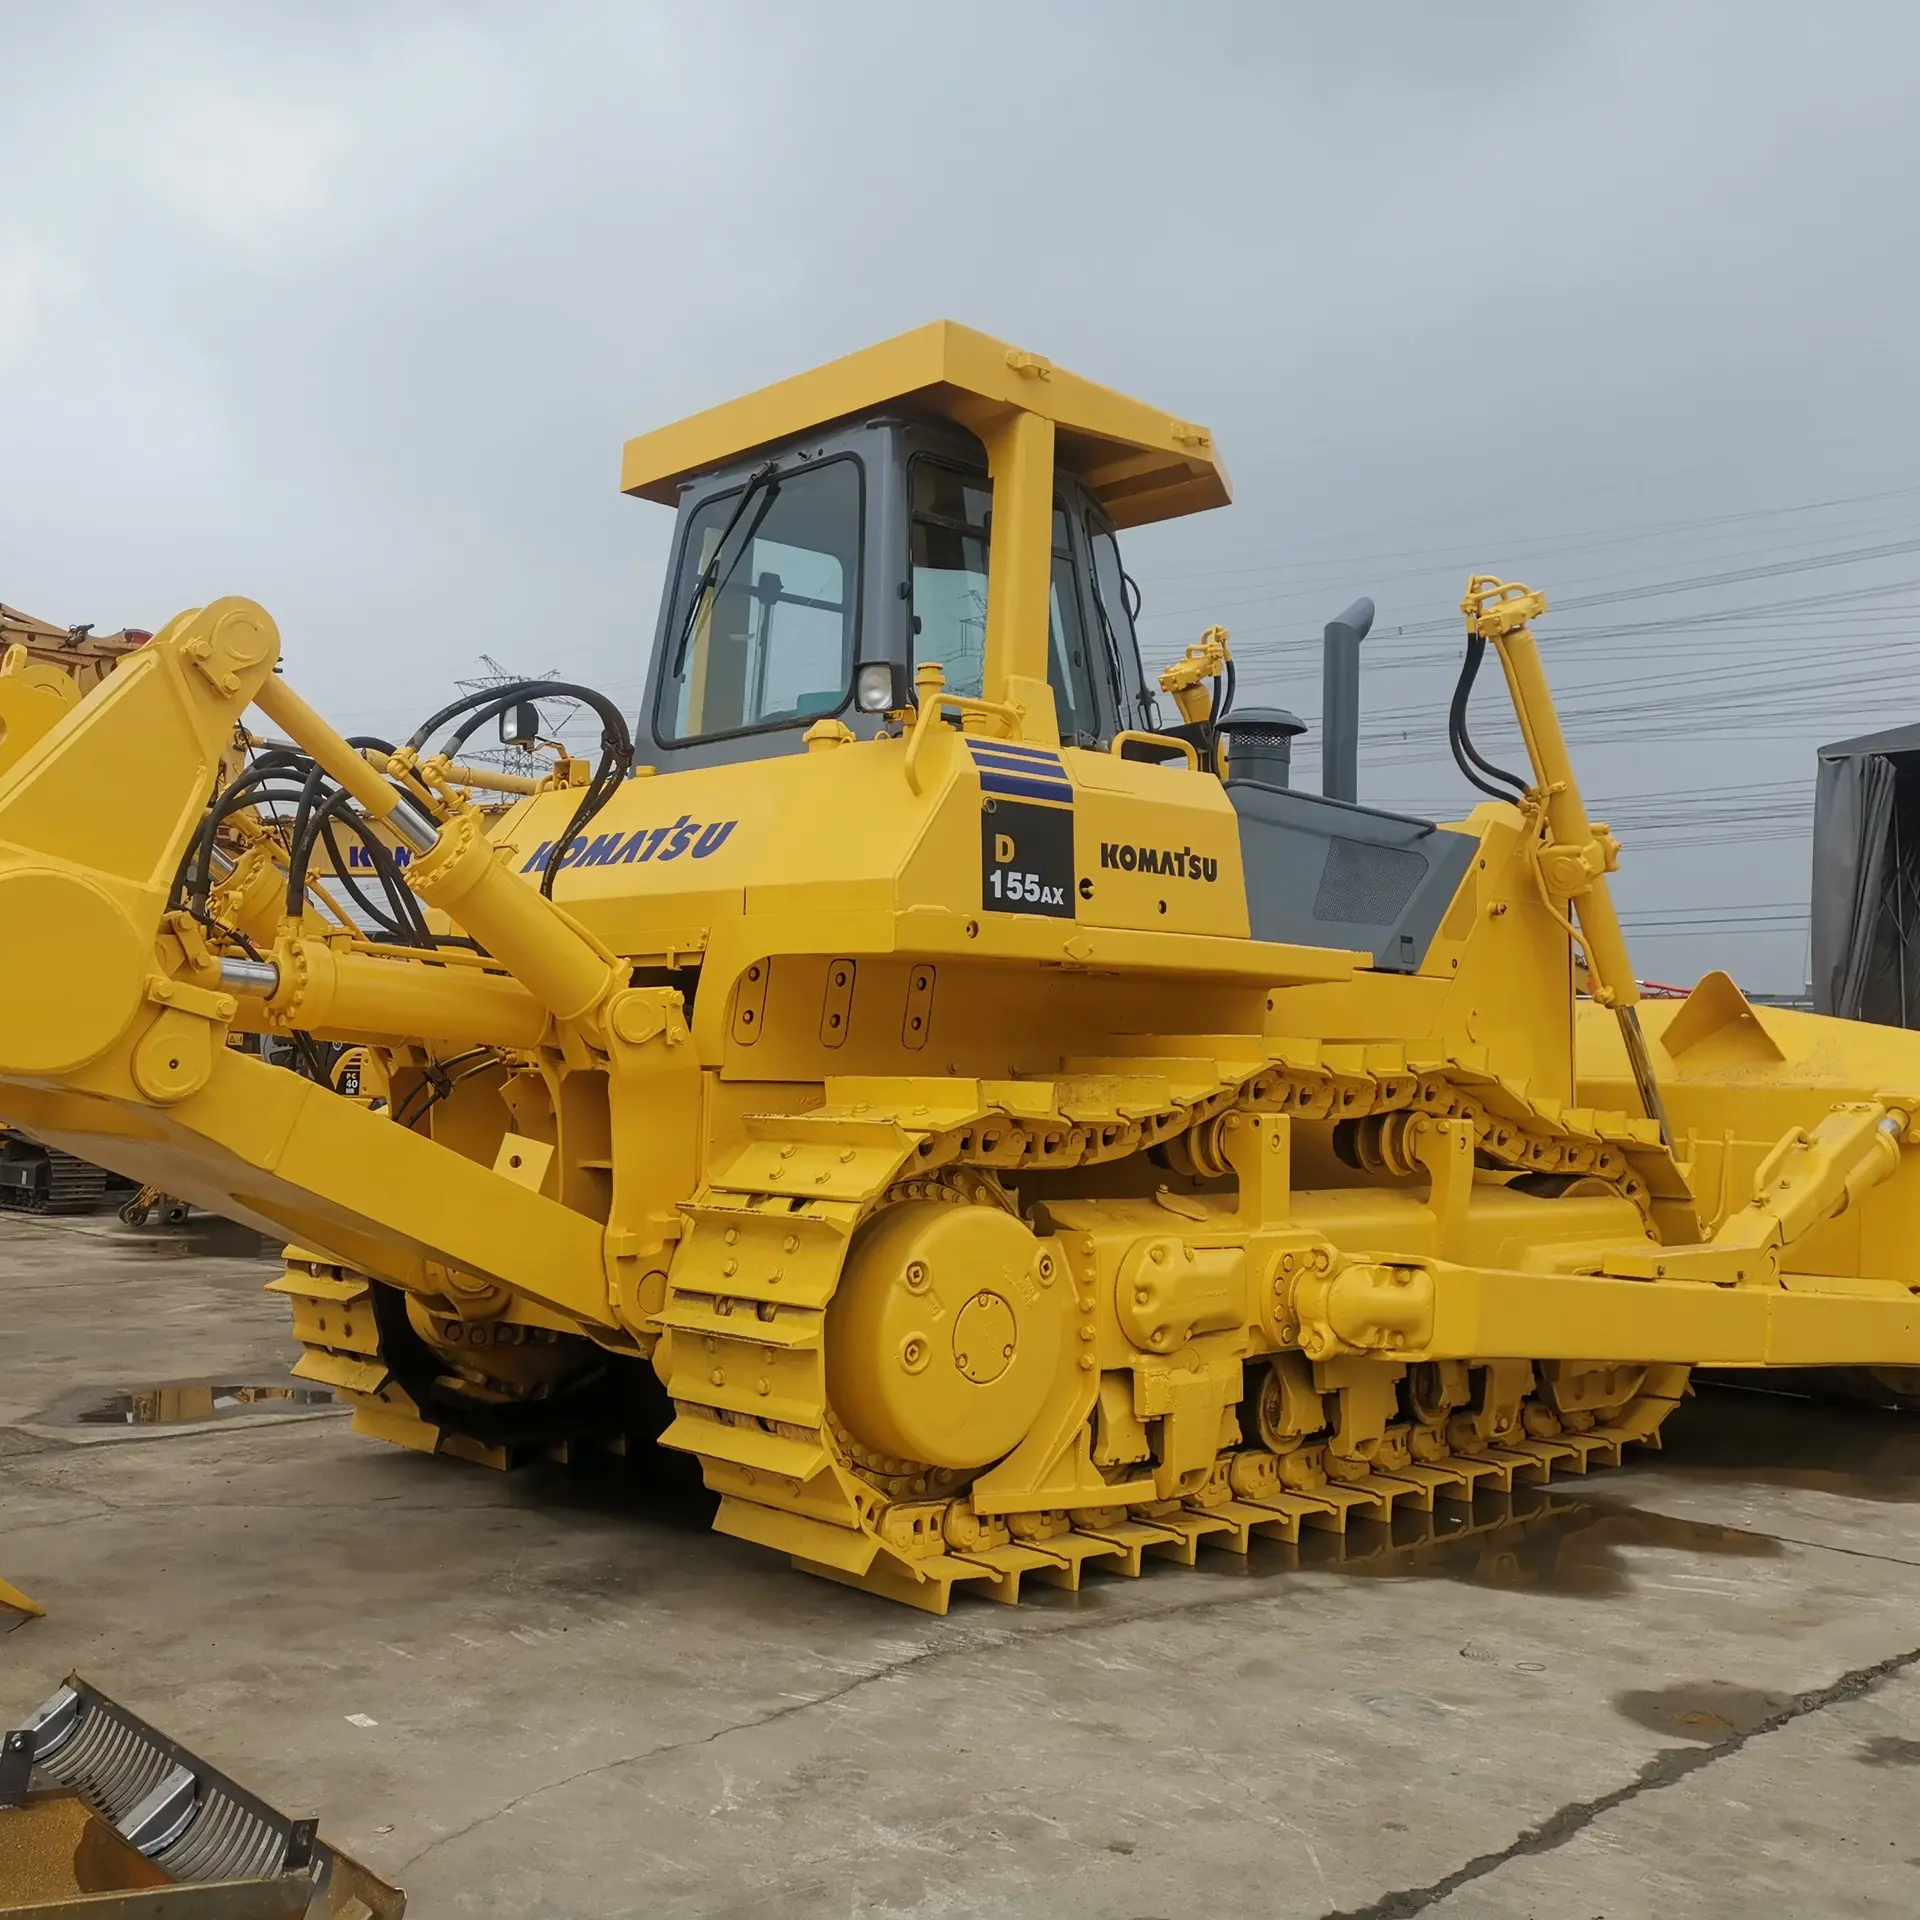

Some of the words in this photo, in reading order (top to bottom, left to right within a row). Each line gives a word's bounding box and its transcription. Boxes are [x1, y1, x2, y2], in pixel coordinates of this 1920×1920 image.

[519, 814, 739, 874] KOMATSU
[995, 833, 1016, 864] D
[1100, 842, 1218, 883] KOMATSU
[989, 869, 1065, 905] 155AX
[345, 1079, 358, 1089] 40
[346, 1072, 357, 1080] PC
